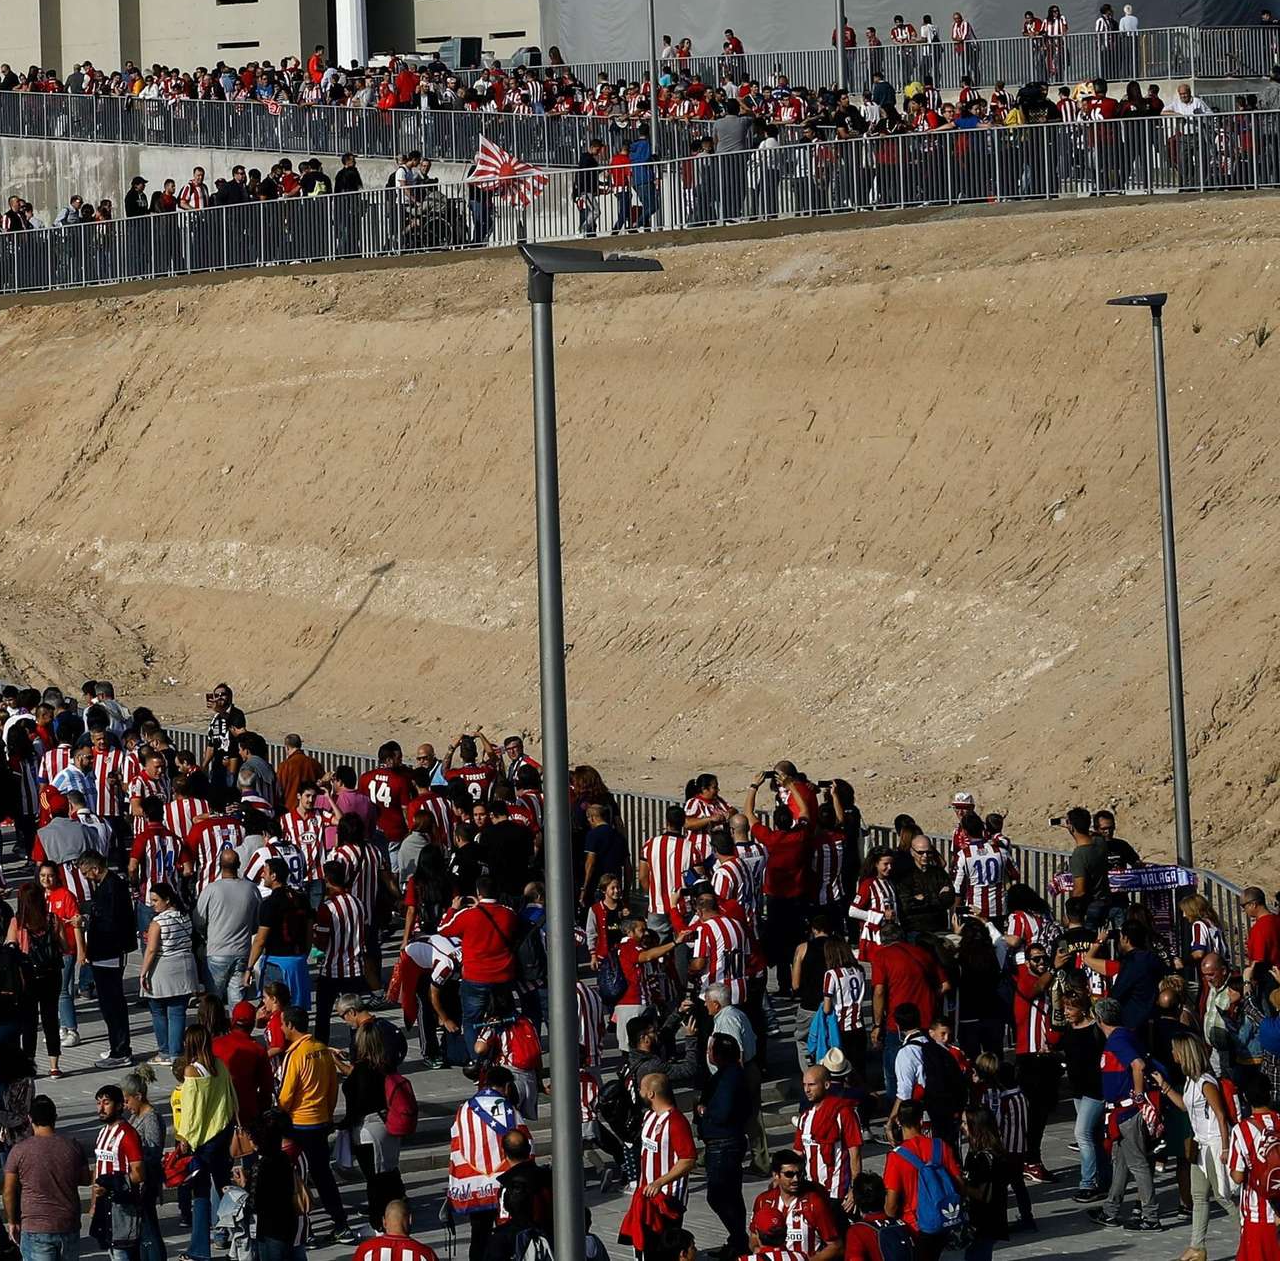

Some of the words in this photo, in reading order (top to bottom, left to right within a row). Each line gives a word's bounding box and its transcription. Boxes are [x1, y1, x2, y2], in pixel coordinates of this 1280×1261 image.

[368, 779, 392, 808] 14
[301, 833, 314, 841] KIA
[973, 858, 999, 885] 10
[849, 976, 861, 1002] 8
